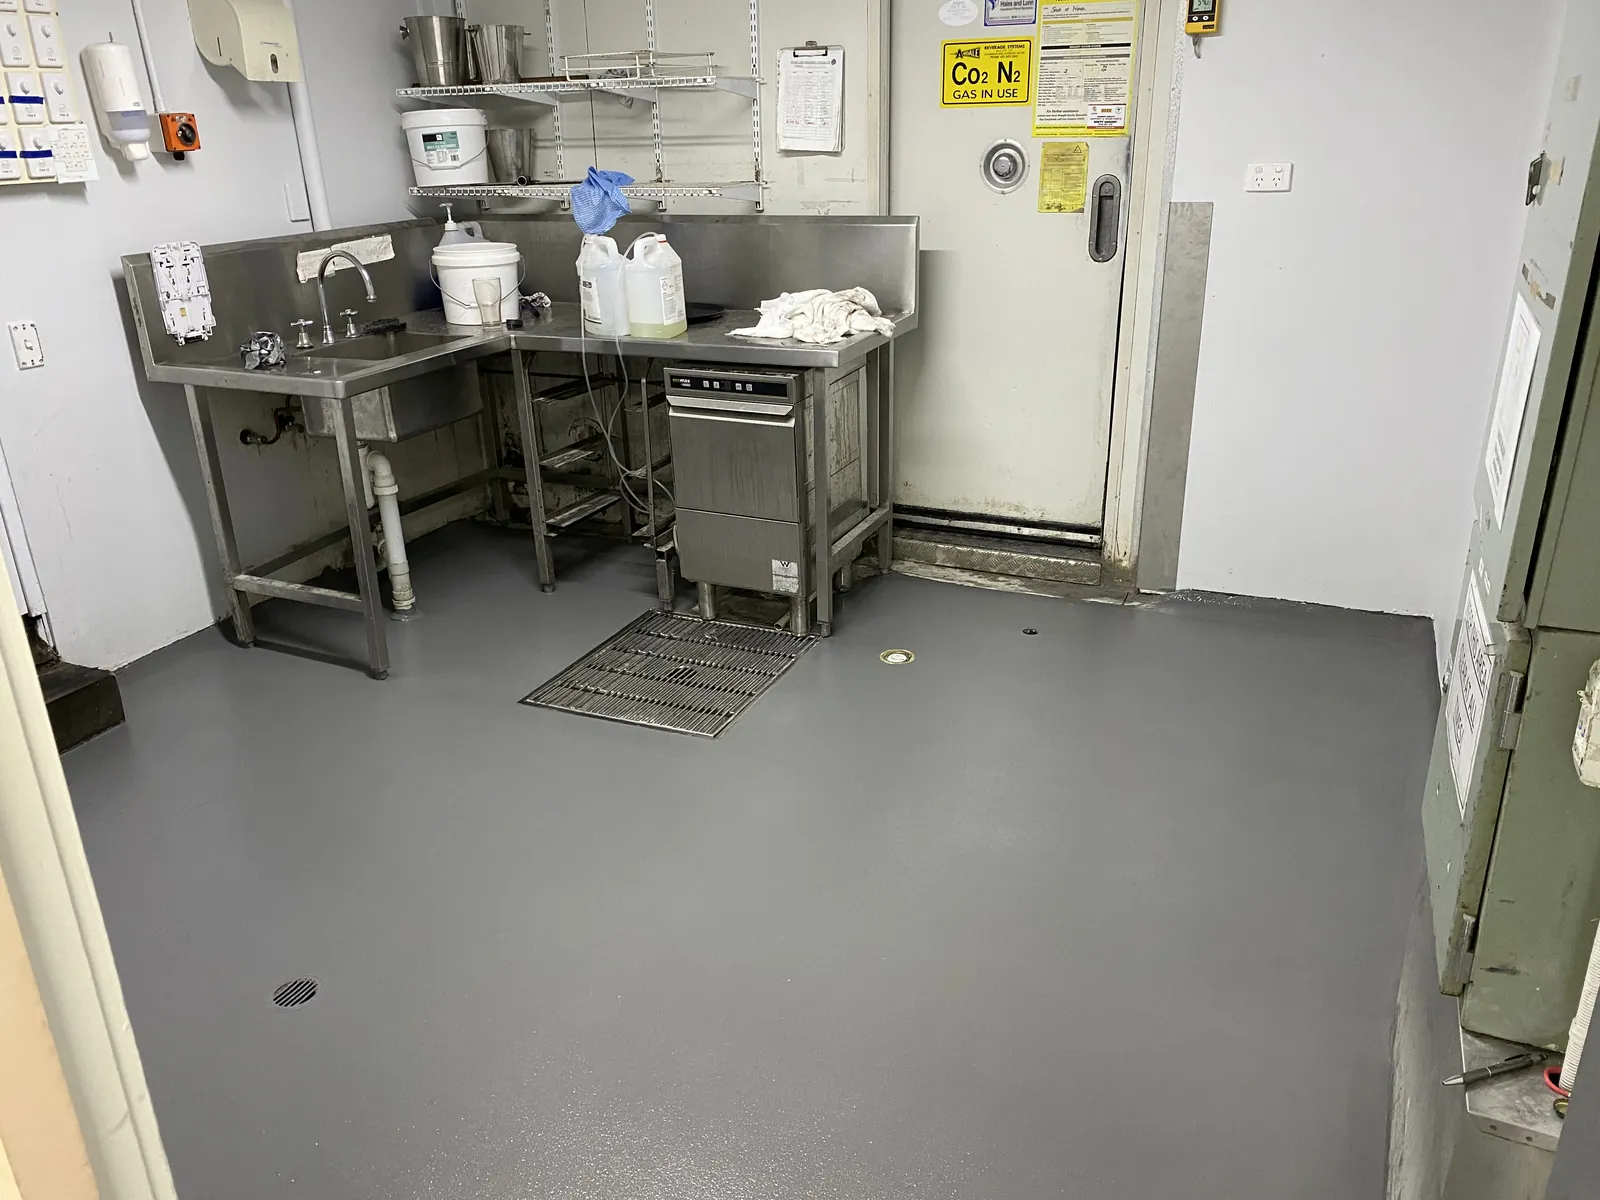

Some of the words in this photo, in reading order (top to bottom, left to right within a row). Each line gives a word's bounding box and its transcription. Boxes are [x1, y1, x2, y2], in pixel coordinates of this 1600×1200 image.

[952, 90, 977, 99] GAS
[981, 89, 993, 98] IN
[997, 88, 1018, 98] USE
